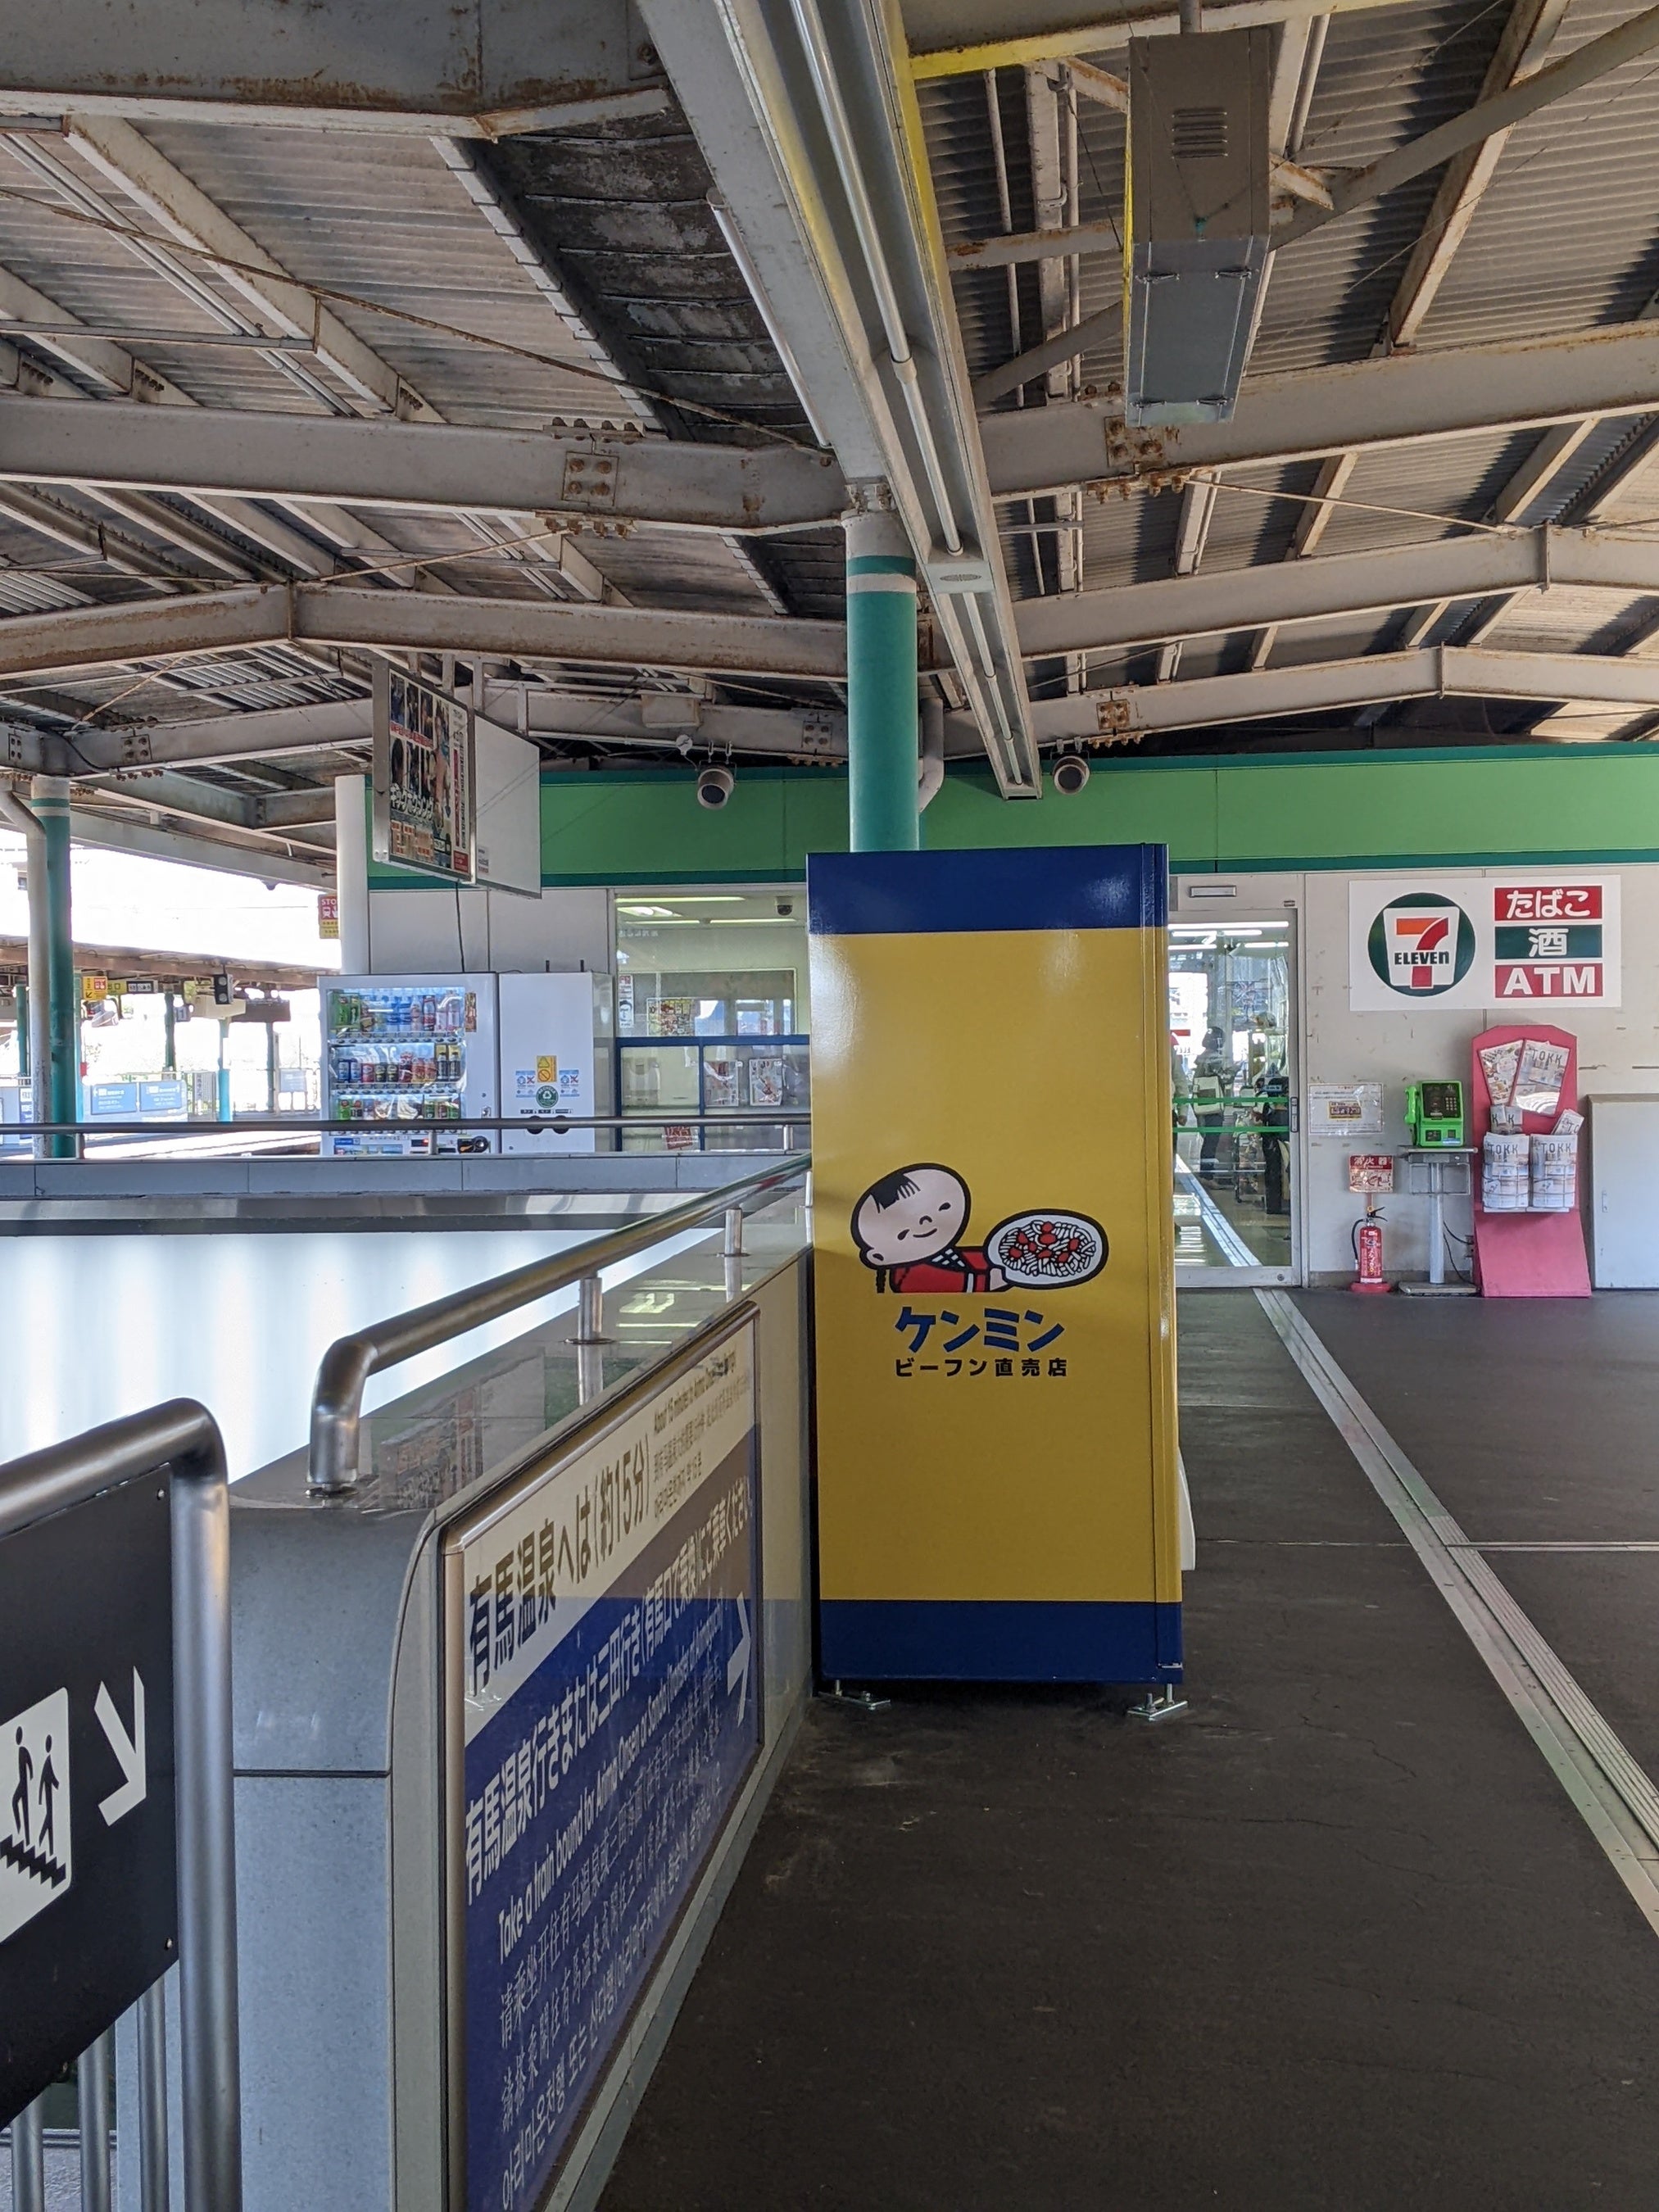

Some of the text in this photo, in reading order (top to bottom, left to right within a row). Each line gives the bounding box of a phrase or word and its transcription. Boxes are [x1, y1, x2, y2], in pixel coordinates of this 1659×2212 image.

[1507, 889, 1592, 919] たばこ
[1528, 927, 1569, 958] 酒
[1503, 966, 1596, 995] ATM
[1531, 1049, 1563, 1067] TOKK
[1489, 1144, 1519, 1157] TOKK
[1541, 1142, 1571, 1155] TOKK
[895, 1306, 1065, 1353] ケンミン
[895, 1357, 1067, 1377] ビーフン直売店
[500, 1887, 523, 1964] Take
[534, 1839, 555, 1909] train
[555, 1797, 582, 1873] bound
